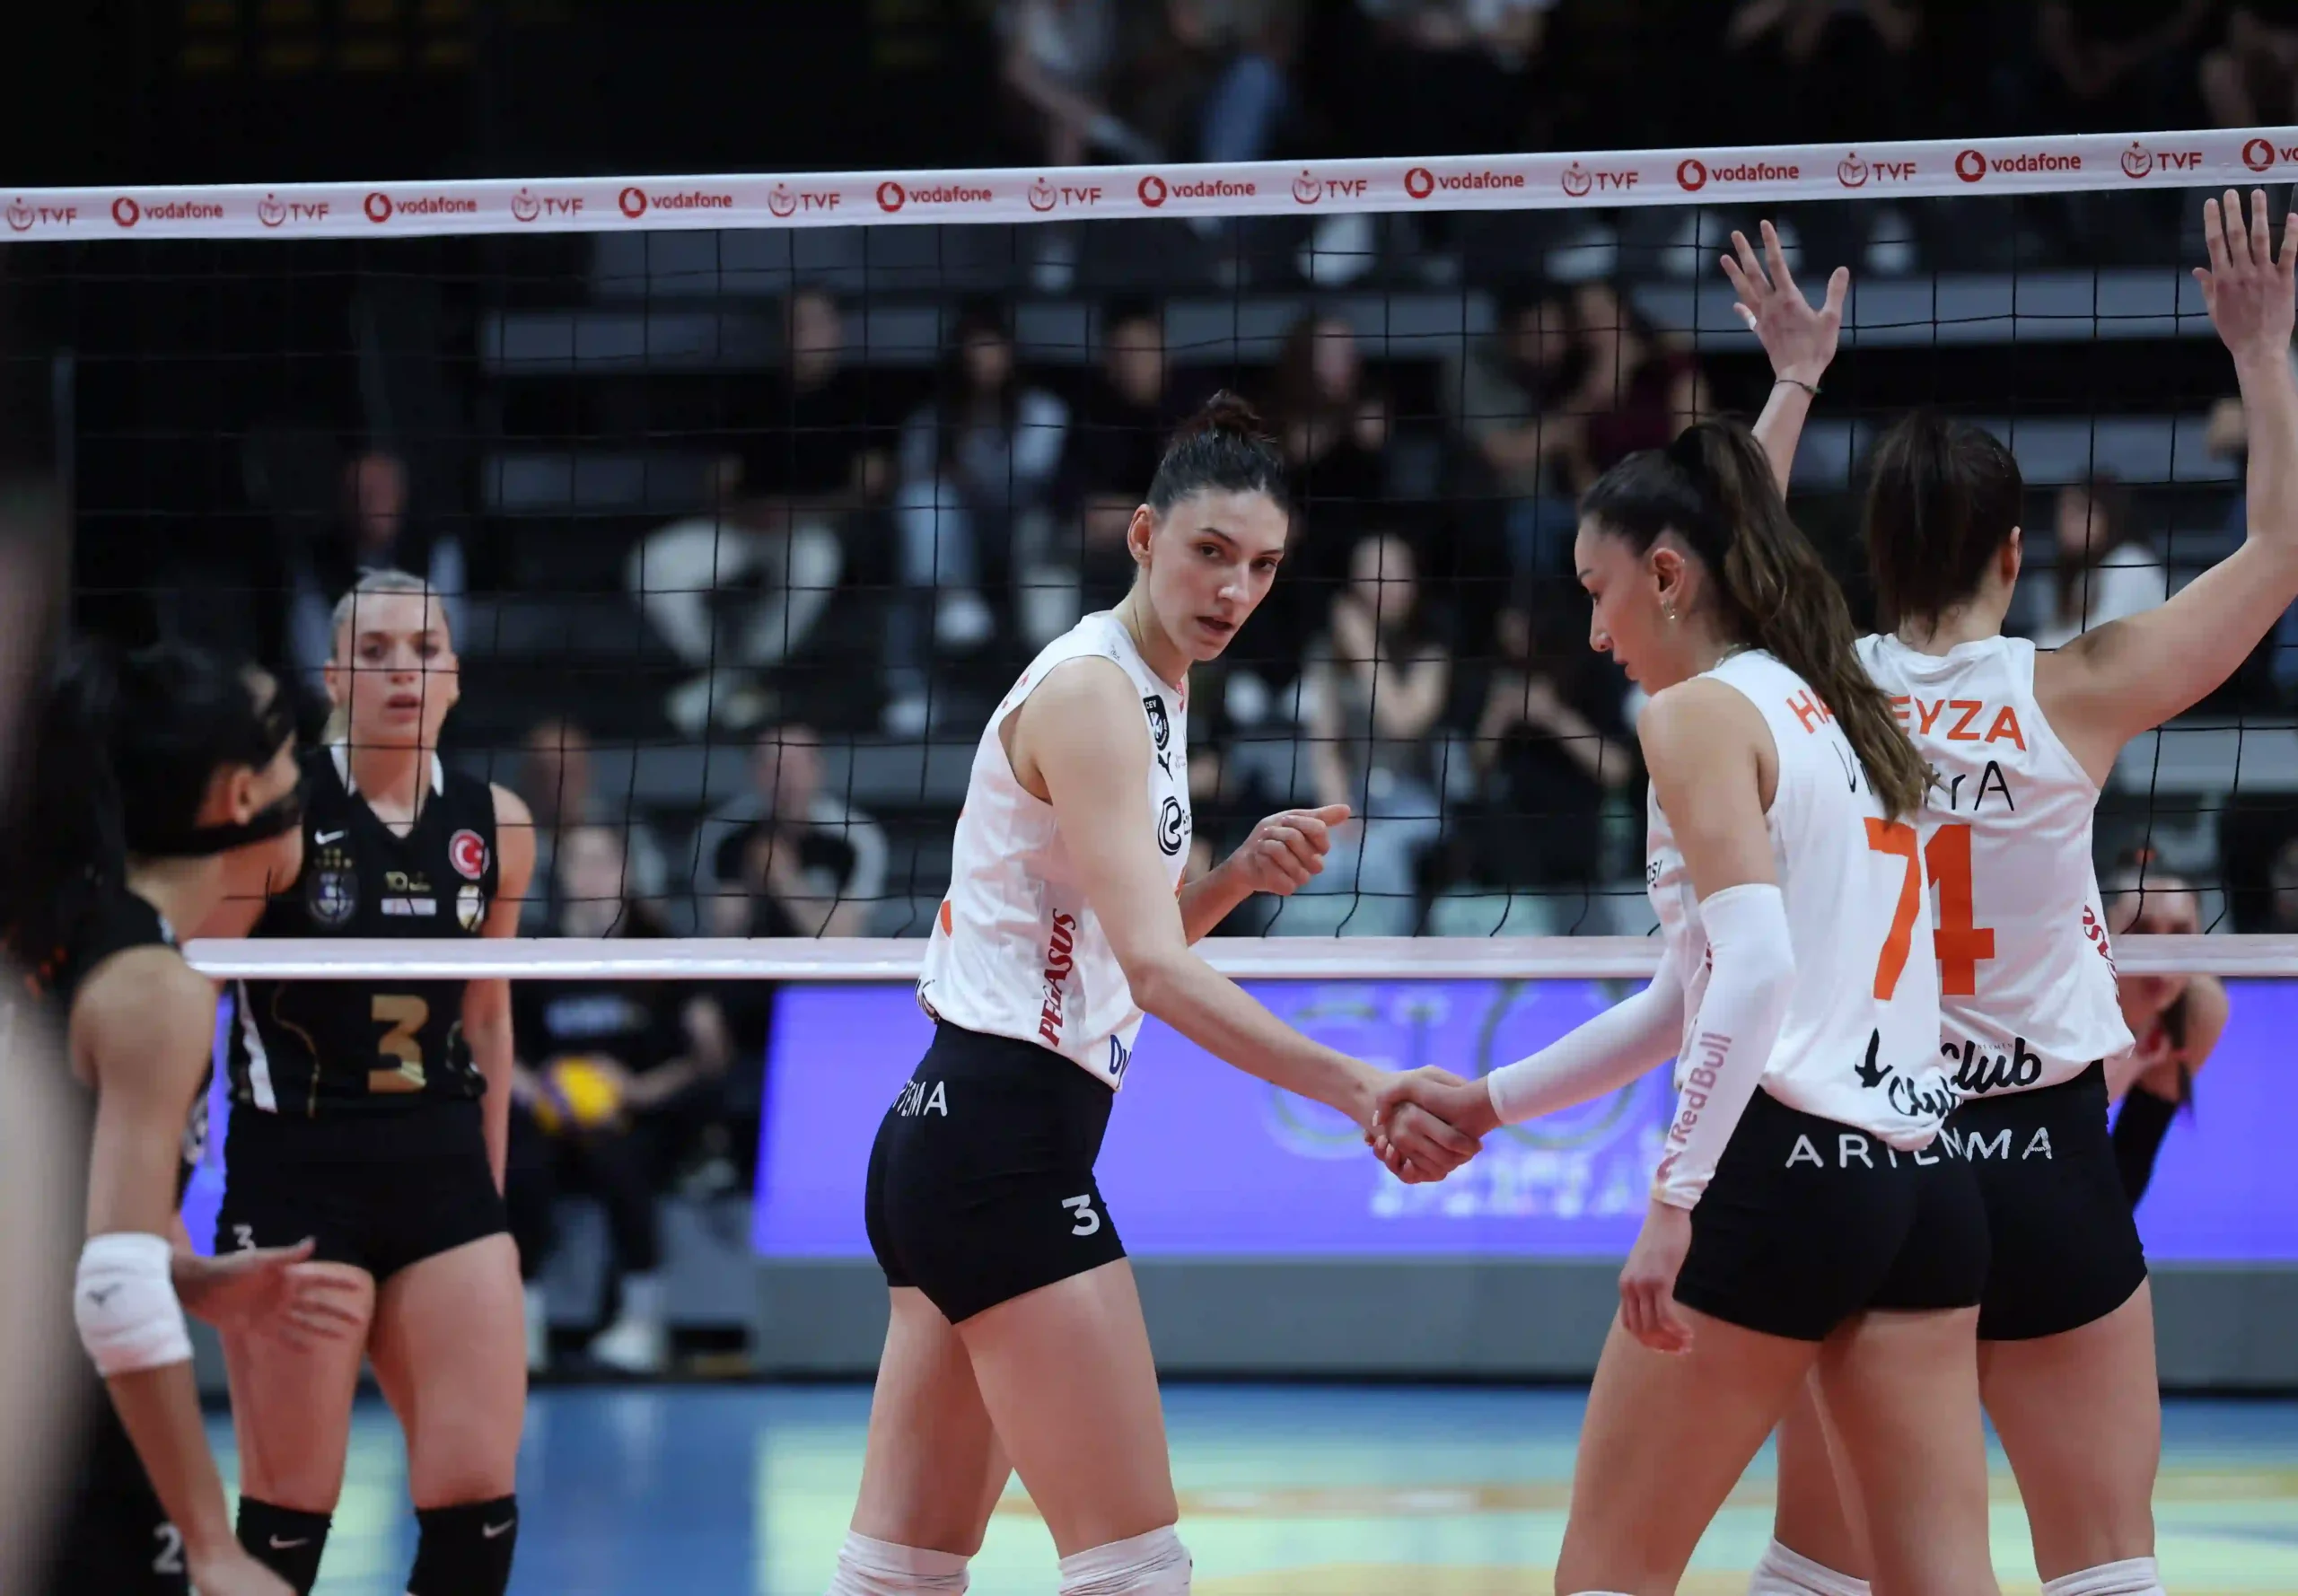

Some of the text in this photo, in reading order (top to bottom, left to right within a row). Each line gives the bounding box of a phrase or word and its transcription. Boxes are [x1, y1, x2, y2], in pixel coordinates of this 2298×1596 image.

[39, 150, 2204, 223] TVF vodafone TVF vodafone TVF vodafone TVF vodafone TVF vodafone TVF vodafone TVF vodafone TVF vodafone TVF
[1890, 694, 2027, 752] EYZA
[1863, 816, 1922, 1002] 7
[1038, 908, 1076, 1048] PEGASUS
[369, 993, 430, 1093] 3
[1061, 1193, 1101, 1237] 3
[151, 1521, 184, 1575] 2
